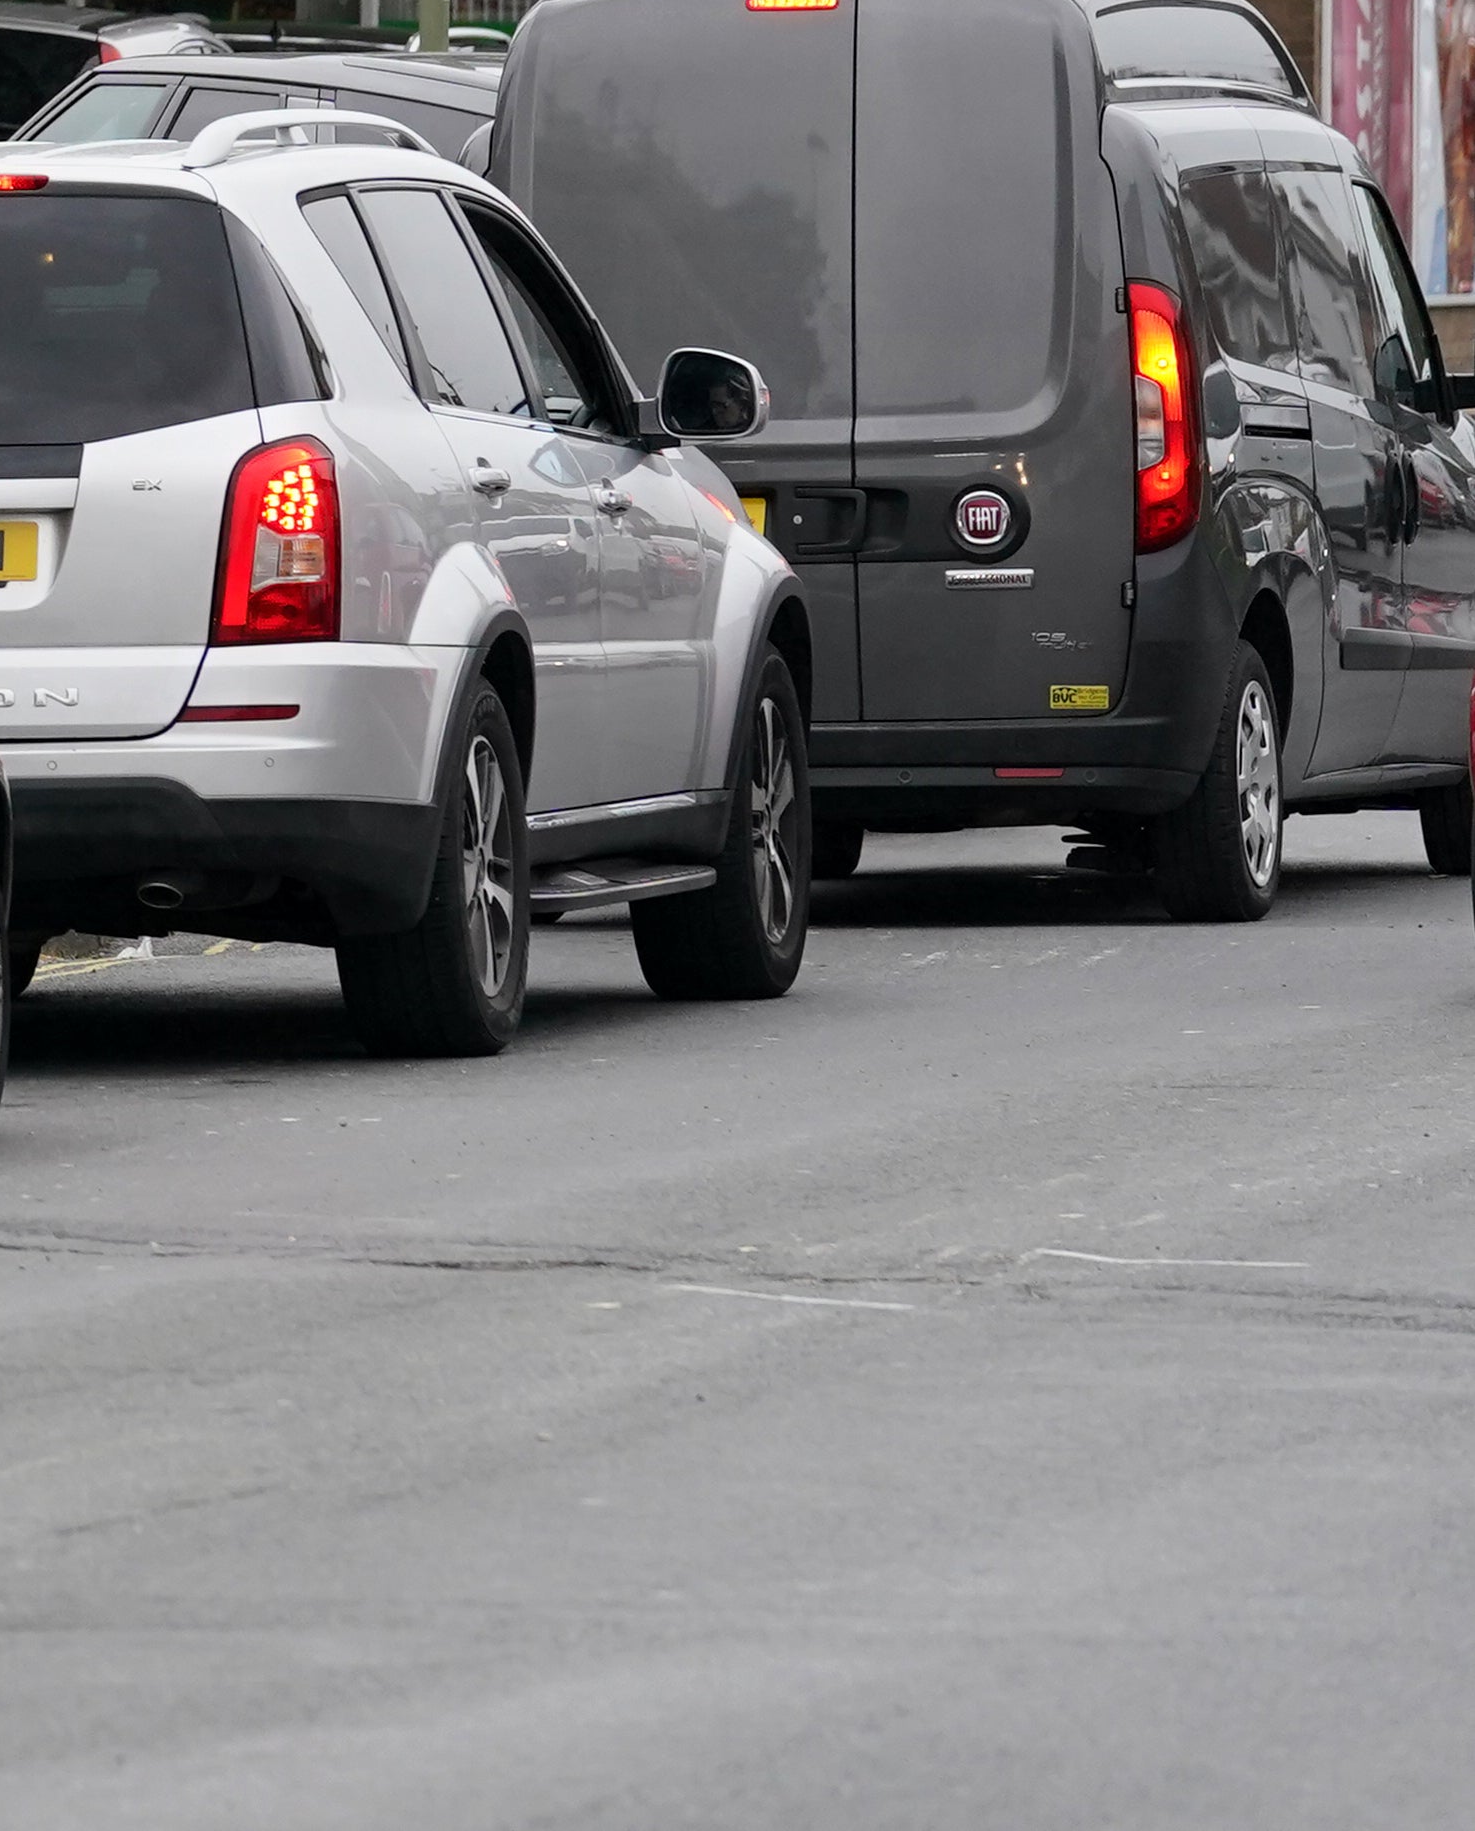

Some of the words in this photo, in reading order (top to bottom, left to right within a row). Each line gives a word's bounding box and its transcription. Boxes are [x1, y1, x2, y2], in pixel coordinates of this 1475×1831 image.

[131, 477, 163, 492] EX
[966, 506, 1000, 532] FIAT
[1052, 692, 1078, 704] BVC
